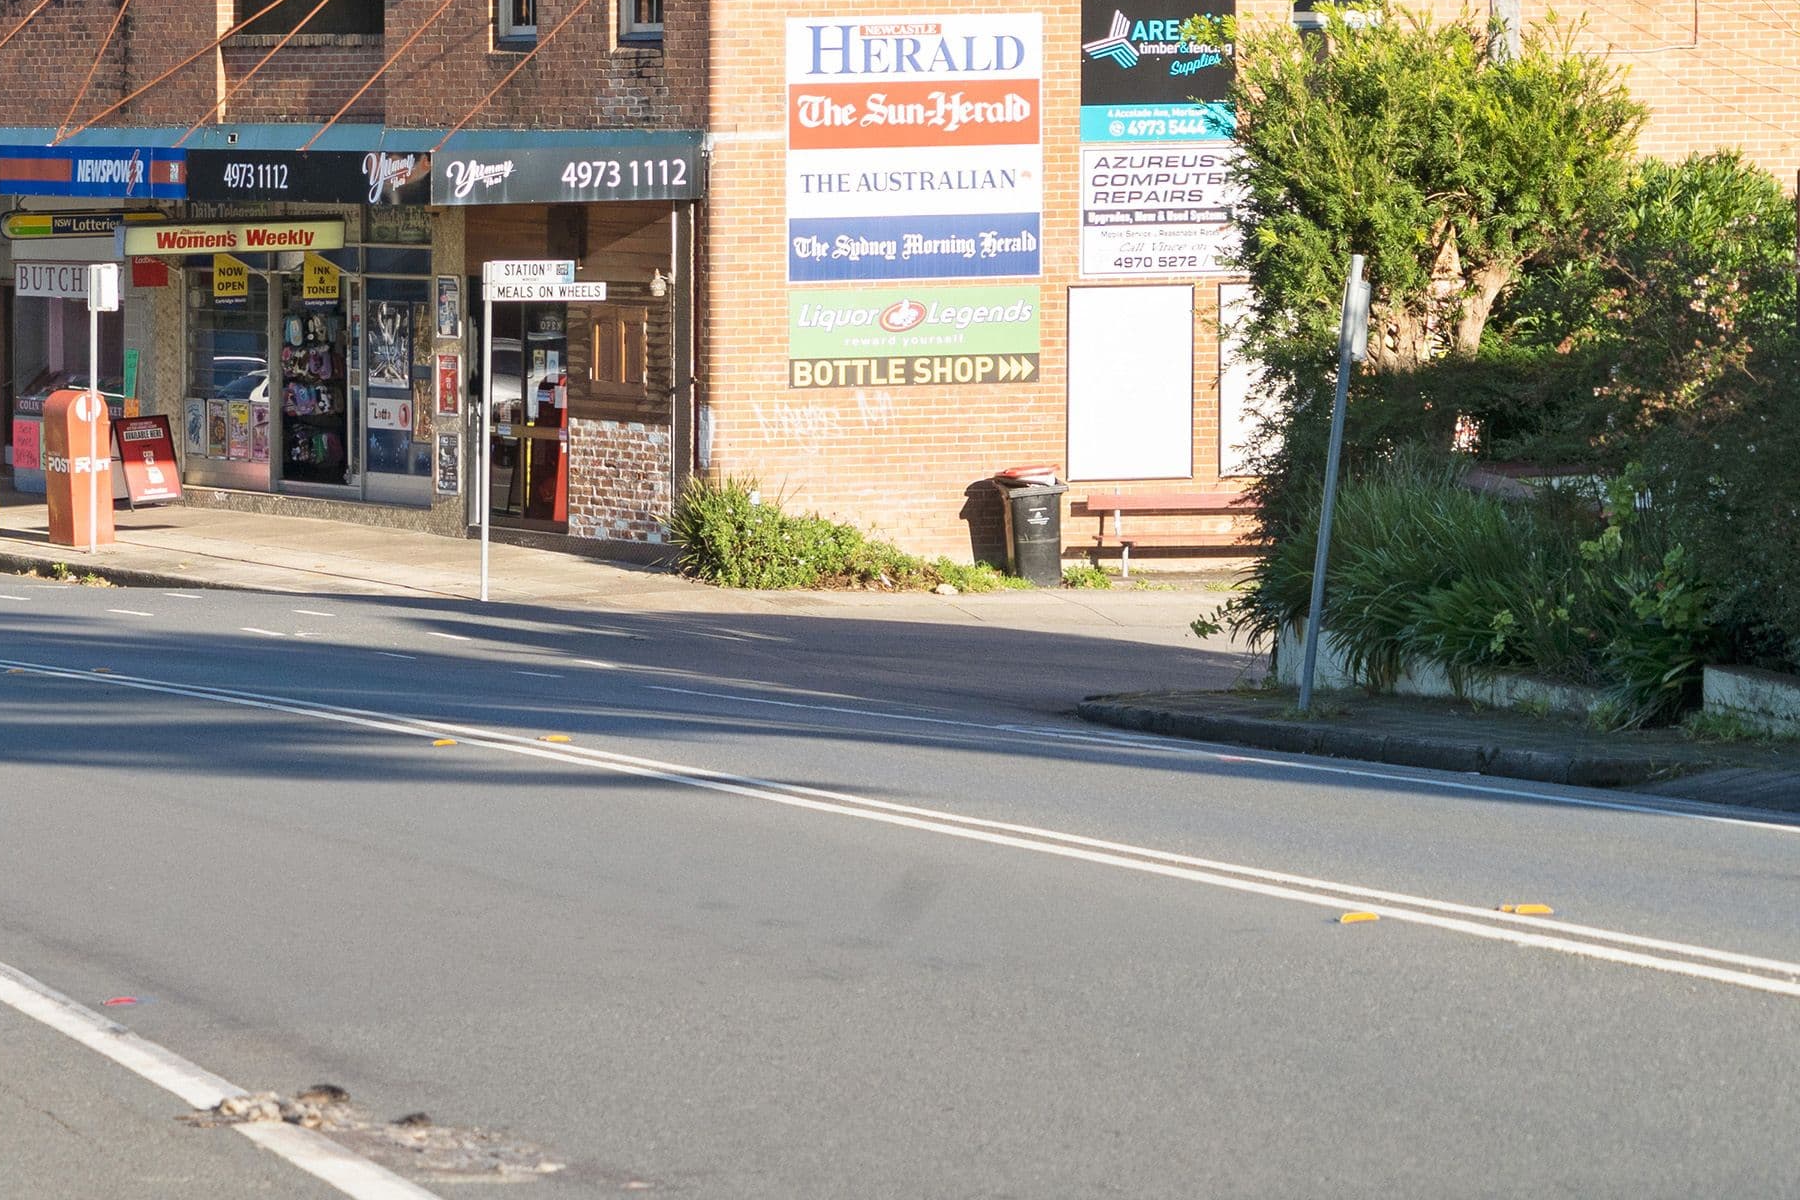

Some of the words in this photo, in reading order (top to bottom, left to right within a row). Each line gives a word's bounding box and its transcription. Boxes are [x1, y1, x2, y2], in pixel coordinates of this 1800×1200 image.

[864, 24, 938, 35] NEWCASTLE
[805, 25, 1025, 75] HERALD
[1169, 53, 1221, 76] Supplies
[797, 94, 857, 128] The
[860, 91, 1031, 132] Sun-Herald
[1127, 119, 1166, 136] 4973
[1168, 119, 1207, 135] 5444
[1094, 155, 1215, 169] AZUREUS
[224, 163, 254, 189] 4973
[256, 163, 288, 190] 1112
[362, 152, 415, 203] Yummy
[446, 159, 514, 198] Yummy
[561, 161, 621, 189] 4973
[631, 158, 687, 187] 1112
[800, 173, 850, 194] THE
[856, 169, 1016, 193] AUSTRALIAN
[1093, 189, 1203, 204] REPAIRS
[54, 218, 72, 228] NSW
[1166, 210, 1189, 221] Used
[157, 230, 237, 249] Women's
[246, 229, 315, 247] Weekly
[793, 234, 830, 261] The
[832, 234, 897, 261] Sydney
[902, 232, 977, 260] Morning
[978, 230, 1037, 260] Herald
[313, 266, 330, 274] INK
[505, 264, 545, 276] STATION
[1114, 256, 1153, 268] 4970
[1158, 256, 1197, 267] 5272
[20, 266, 123, 292] BUTCHY
[218, 267, 243, 277] NOW
[319, 276, 325, 284] &
[217, 281, 245, 291] OPEN
[307, 286, 337, 294] TONER
[497, 286, 533, 298] MEALS
[539, 286, 553, 298] ON
[559, 285, 601, 298] WHEELS
[798, 302, 880, 332] Liquor
[926, 299, 1033, 330] Legends
[844, 334, 896, 346] reward
[902, 333, 965, 346] yourself
[793, 358, 907, 387] BOTTLE
[914, 356, 994, 384] SHOP
[48, 457, 70, 474] POST
